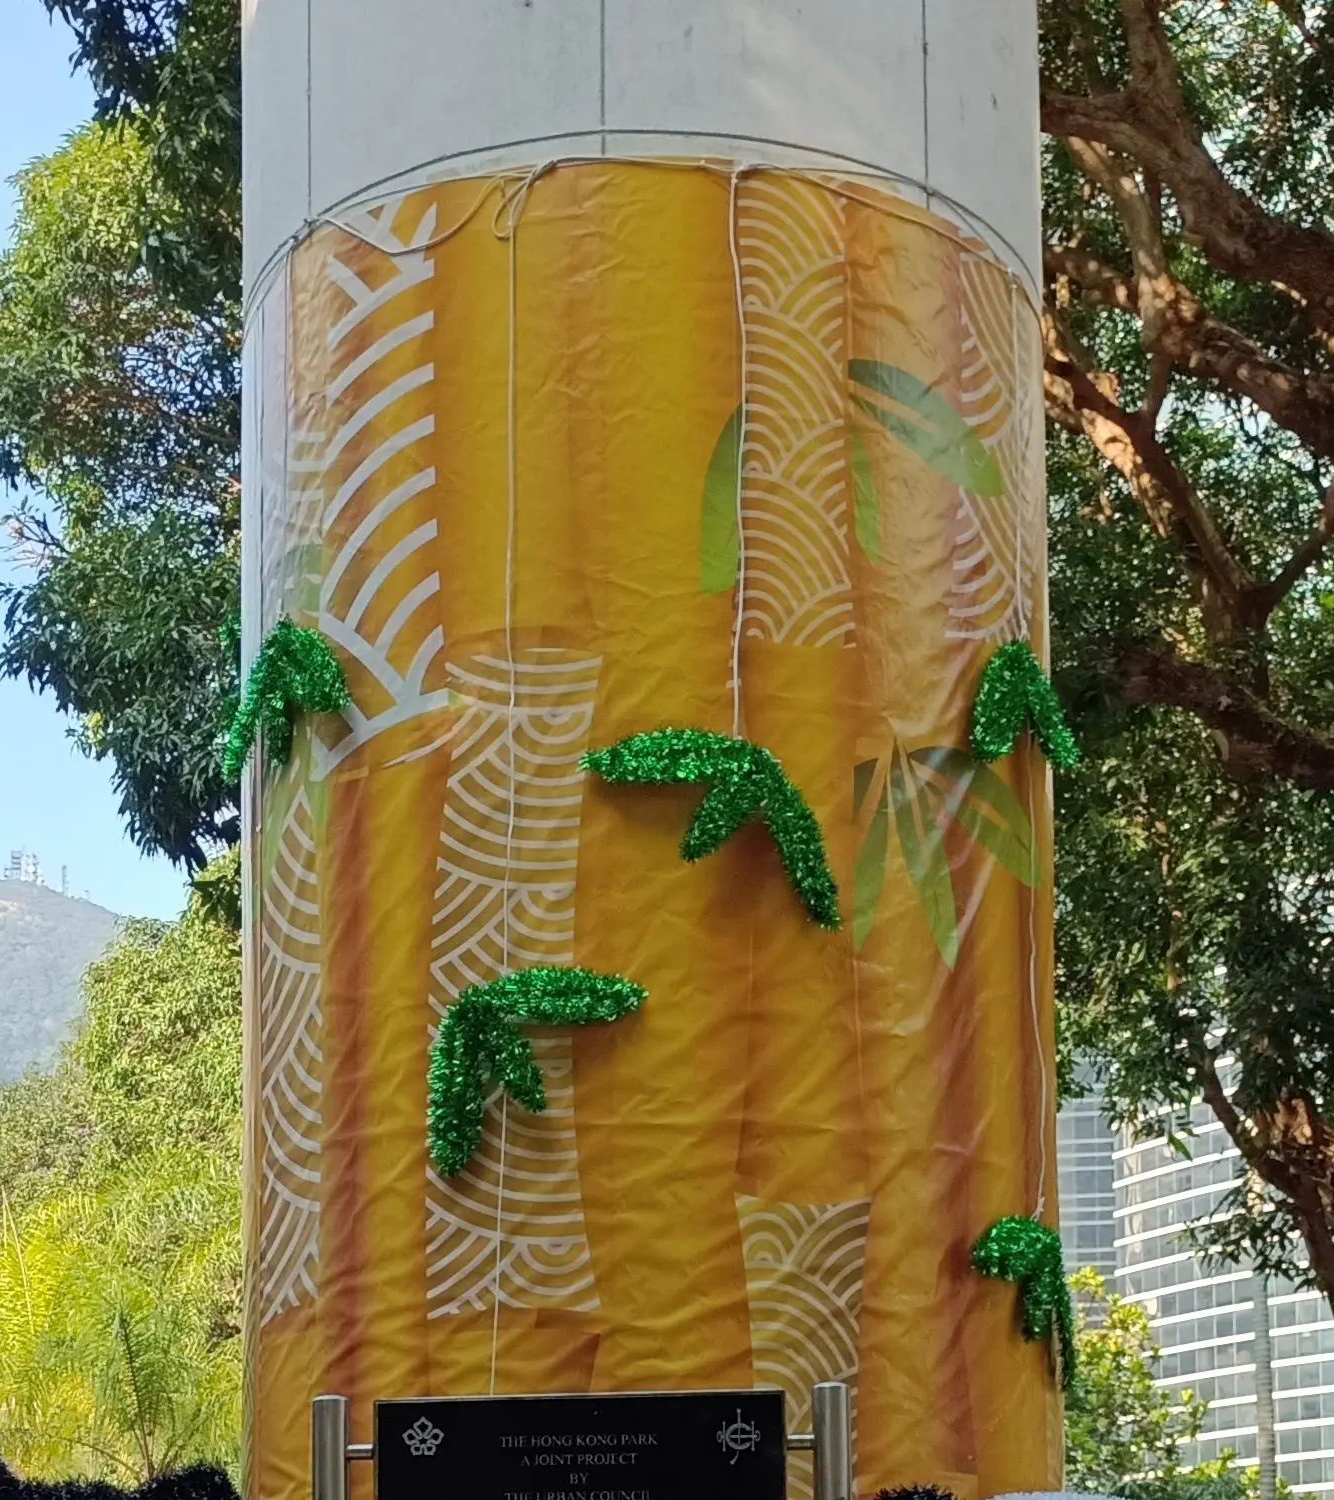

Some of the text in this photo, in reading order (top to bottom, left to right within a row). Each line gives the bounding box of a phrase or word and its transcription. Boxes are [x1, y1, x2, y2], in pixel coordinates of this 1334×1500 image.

[499, 1433, 658, 1448] THE HONG KONG PARK
[521, 1453, 639, 1467] A JOINT PROJECT
[569, 1472, 590, 1485] BY
